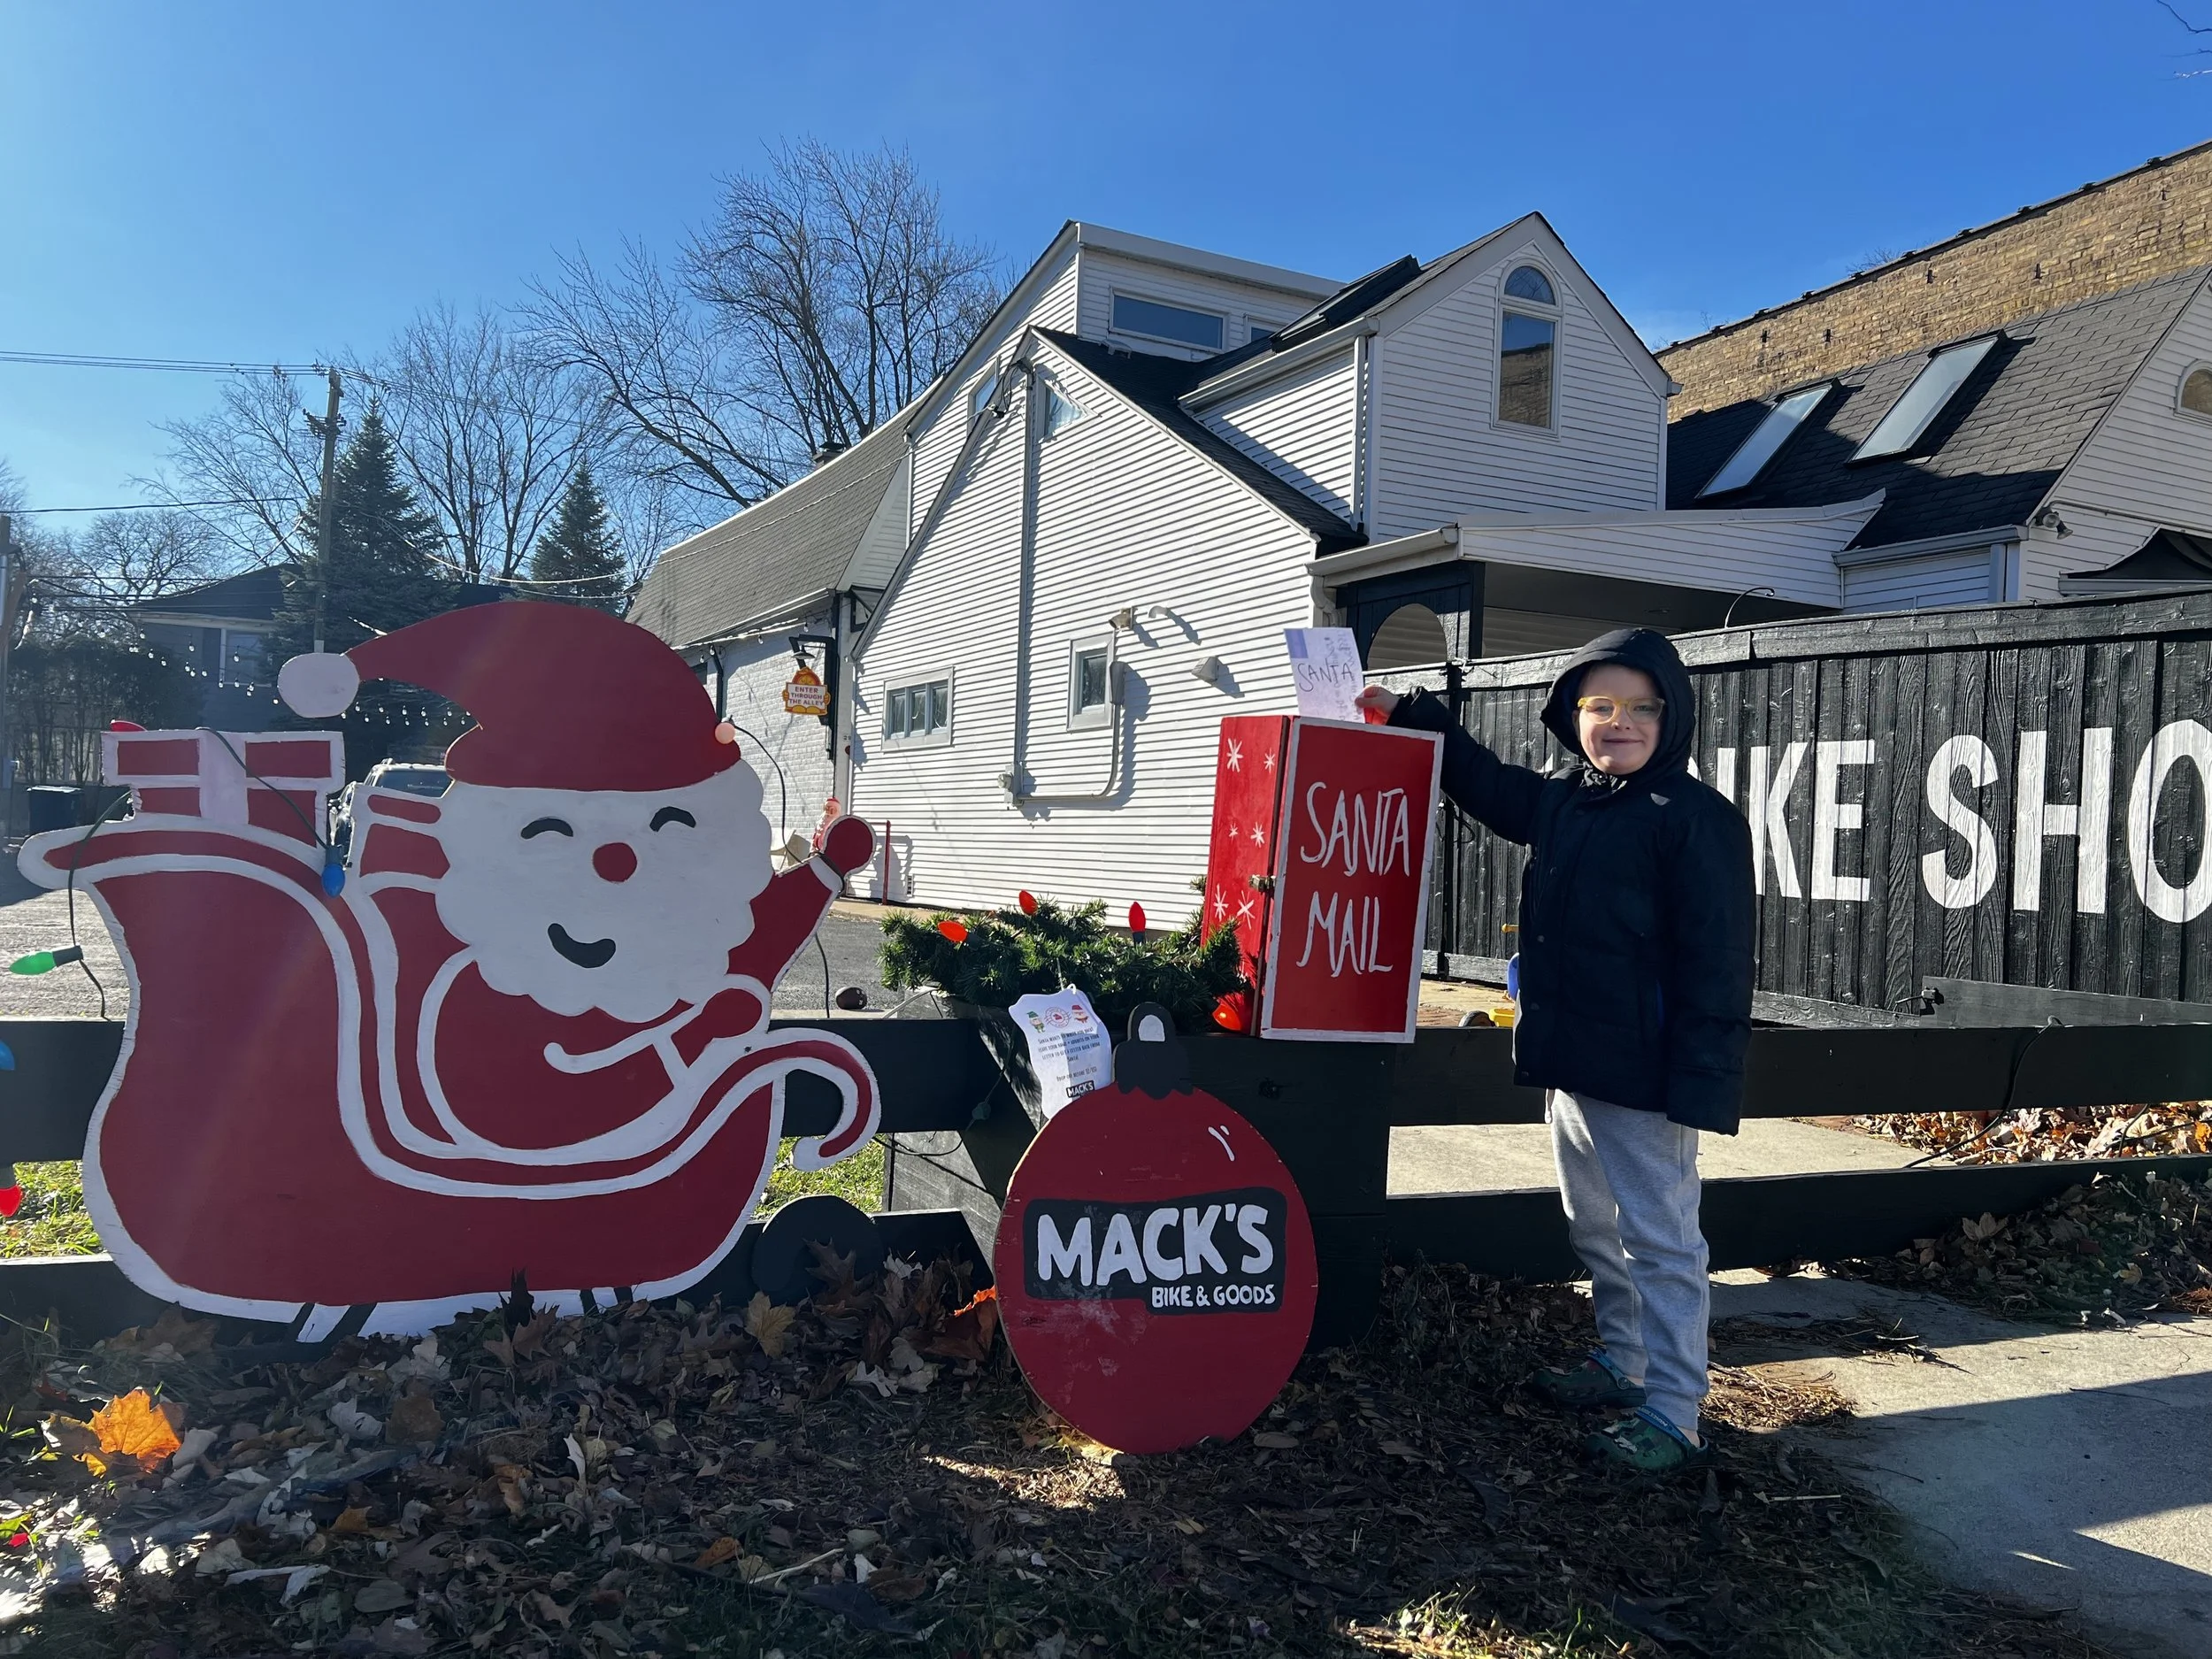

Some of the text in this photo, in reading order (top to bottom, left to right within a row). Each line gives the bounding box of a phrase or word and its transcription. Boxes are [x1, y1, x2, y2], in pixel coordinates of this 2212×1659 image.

[1297, 657, 1355, 692] SANTA
[1300, 781, 1410, 877] SANTA
[1688, 740, 1876, 902] KE
[1296, 891, 1394, 978] MAIL
[1037, 1202, 1274, 1286] MACK'S
[1151, 1284, 1276, 1308] BIKE & GOODS
